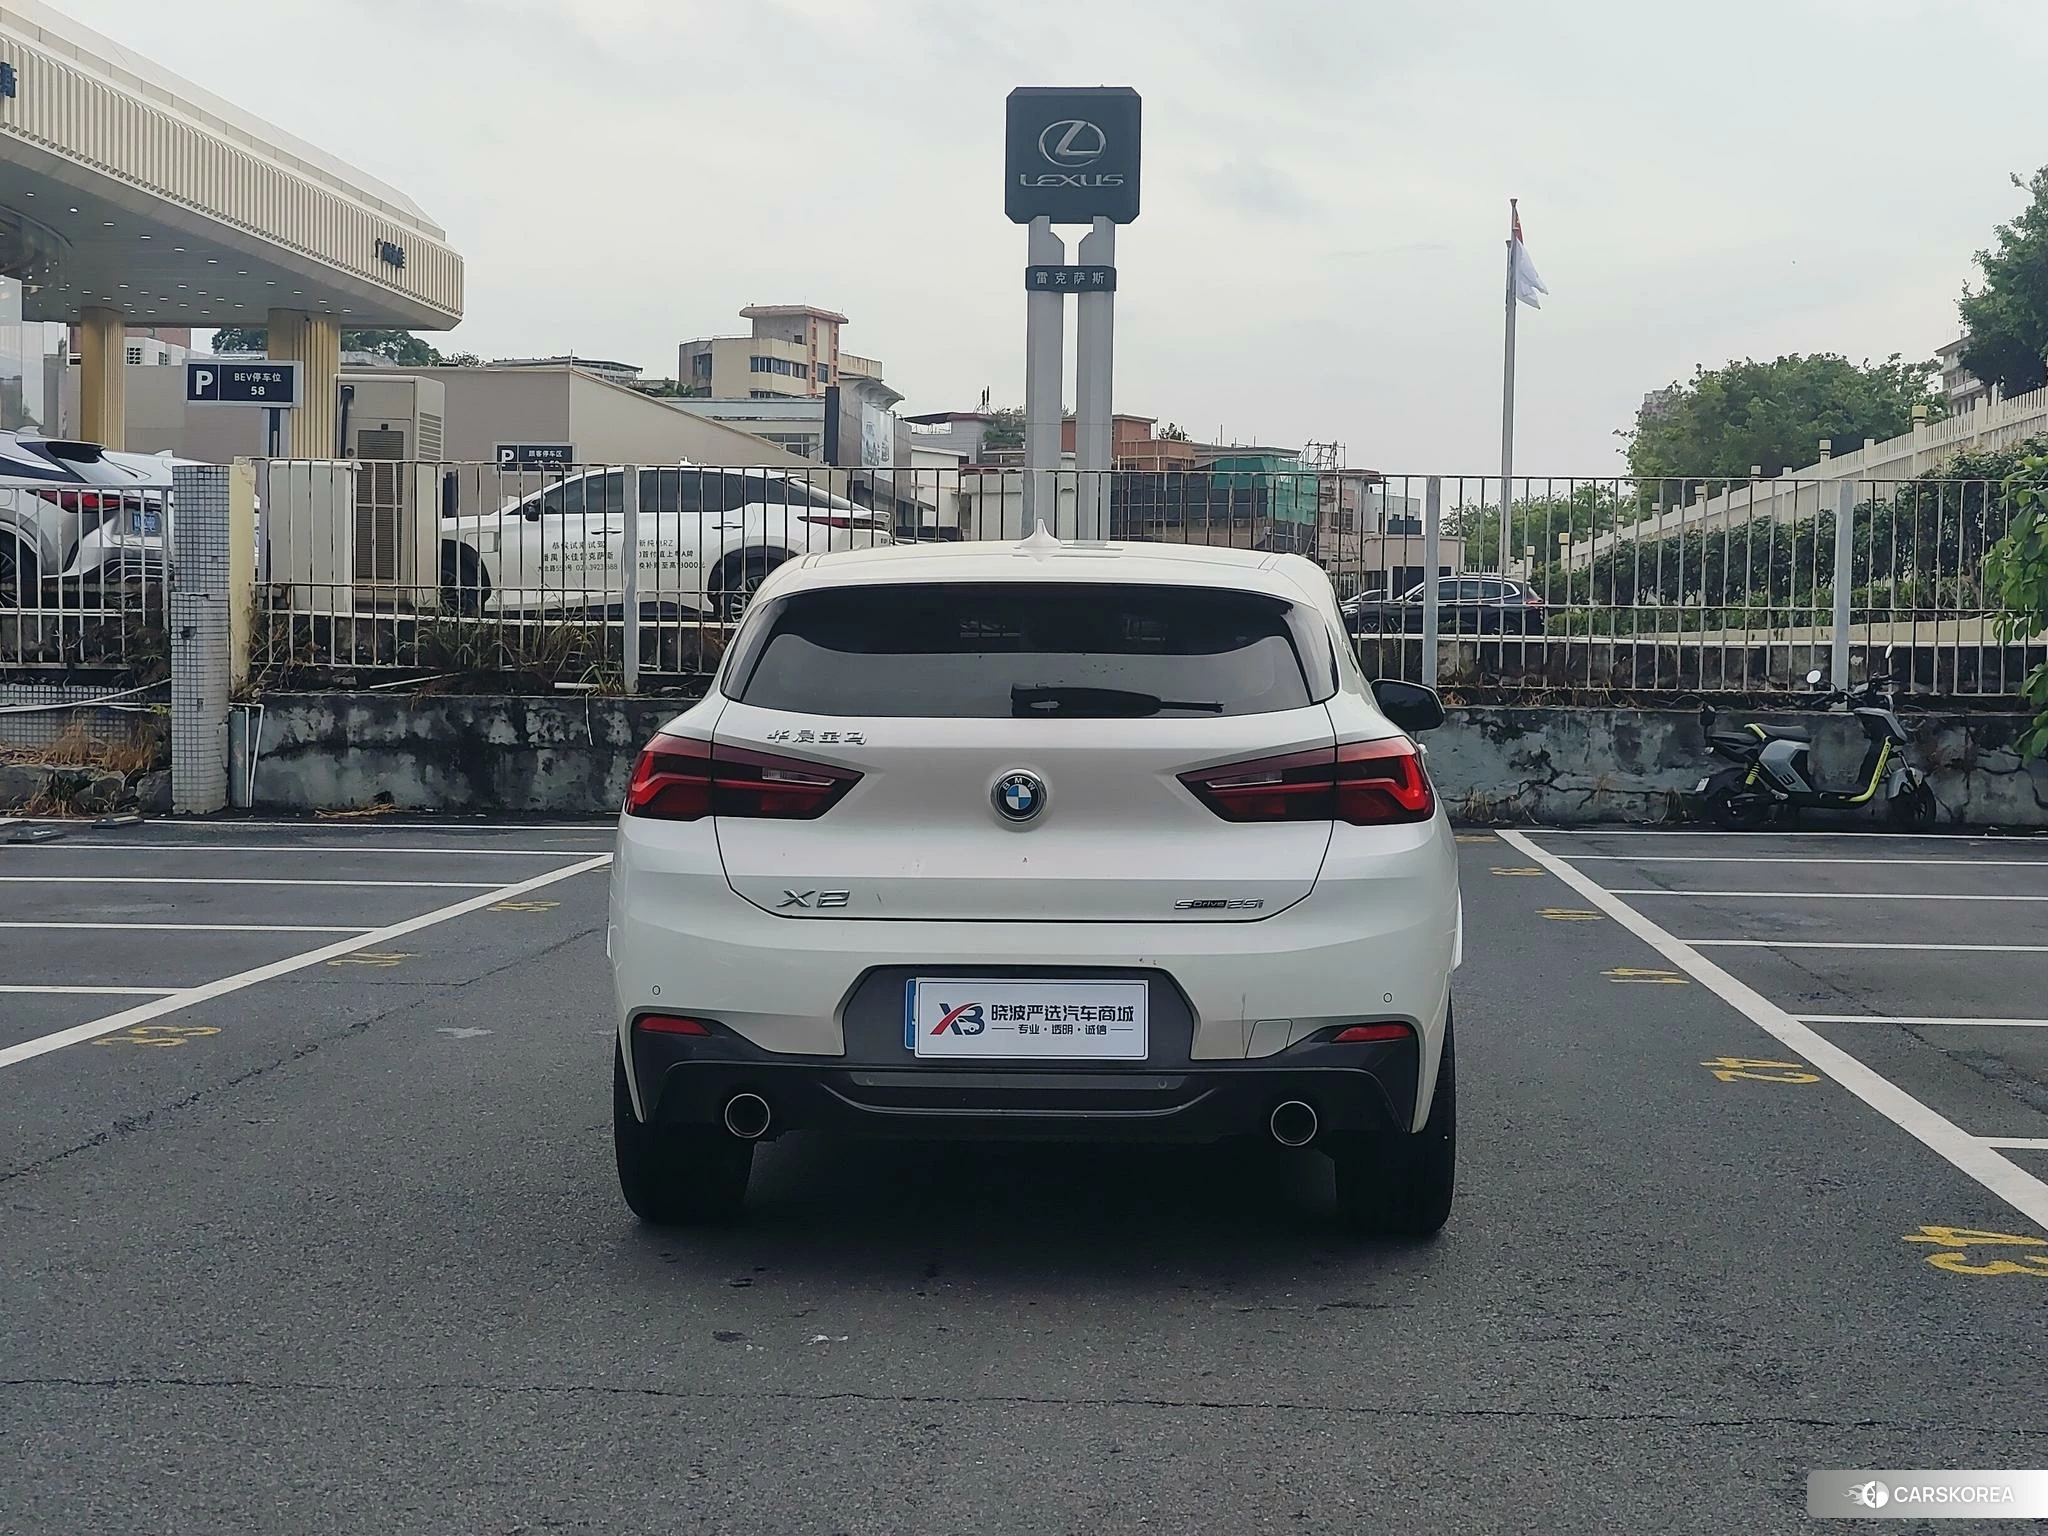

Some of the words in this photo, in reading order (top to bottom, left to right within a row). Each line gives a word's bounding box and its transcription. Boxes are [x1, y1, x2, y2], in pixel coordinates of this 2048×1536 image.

[1019, 173, 1125, 188] LEXUS
[1035, 271, 1105, 285] 雷克萨斯
[195, 370, 214, 395] P
[234, 372, 282, 383] BEV停车位
[250, 386, 265, 396] 58
[501, 449, 515, 467] P
[766, 729, 867, 746] 华晨宝马
[1002, 776, 1036, 791] BMW
[776, 888, 850, 908] X2
[991, 1004, 1134, 1022] 晓波严选汽车商城
[1700, 1056, 1822, 1084] 42
[1902, 1224, 2048, 1277] 43
